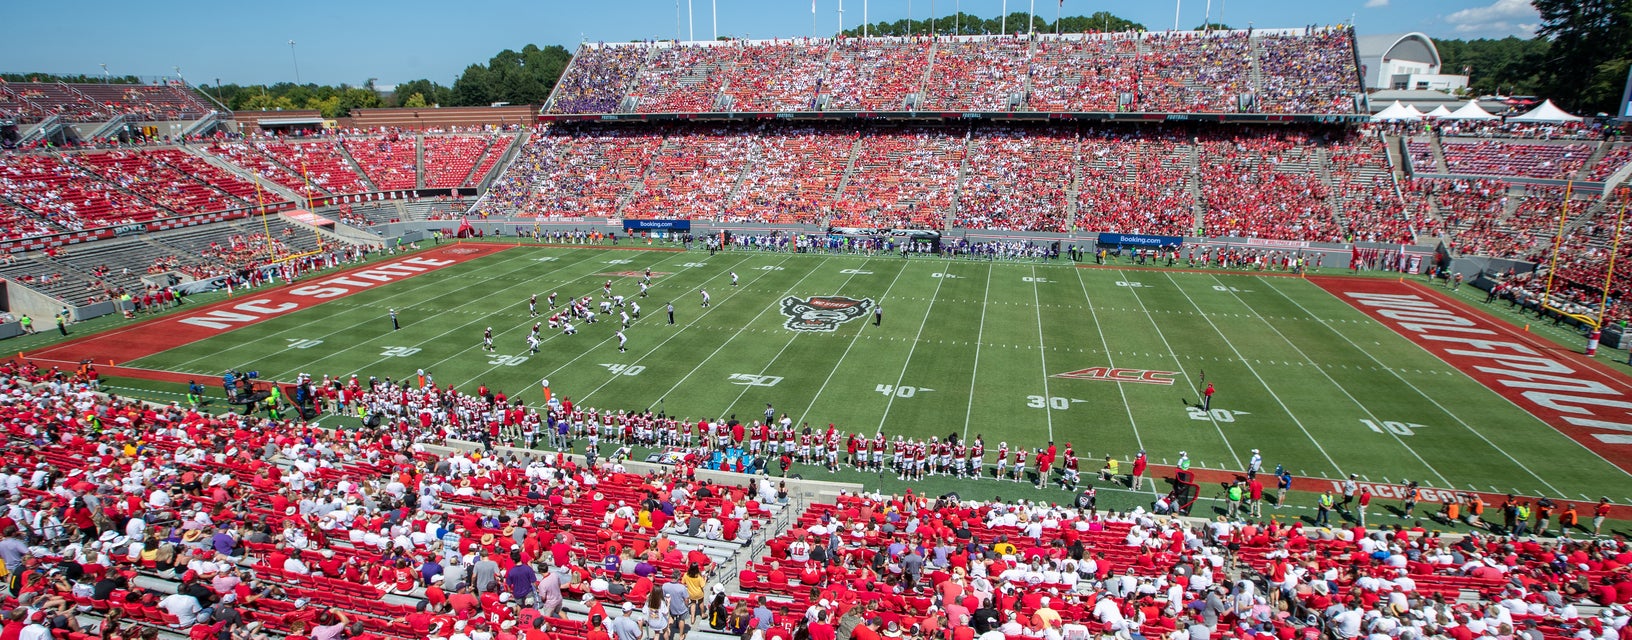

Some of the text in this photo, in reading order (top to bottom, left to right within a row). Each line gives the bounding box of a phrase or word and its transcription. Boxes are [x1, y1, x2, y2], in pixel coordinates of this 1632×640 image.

[332, 190, 419, 205] FOOTBALL
[115, 224, 143, 235] BOWL
[1120, 236, 1161, 244] Booking.com
[178, 256, 455, 330] NC STATE
[287, 338, 324, 349] 10
[379, 346, 422, 357] 20
[488, 354, 529, 366] 30
[607, 363, 647, 376] 40
[1048, 366, 1182, 386] ACC
[730, 373, 785, 387] 50
[875, 383, 916, 399] 40
[1026, 394, 1070, 411] 30
[1185, 406, 1236, 422] 20
[1359, 418, 1415, 436] 10
[711, 611, 717, 626] 1
[735, 617, 740, 629] 1
